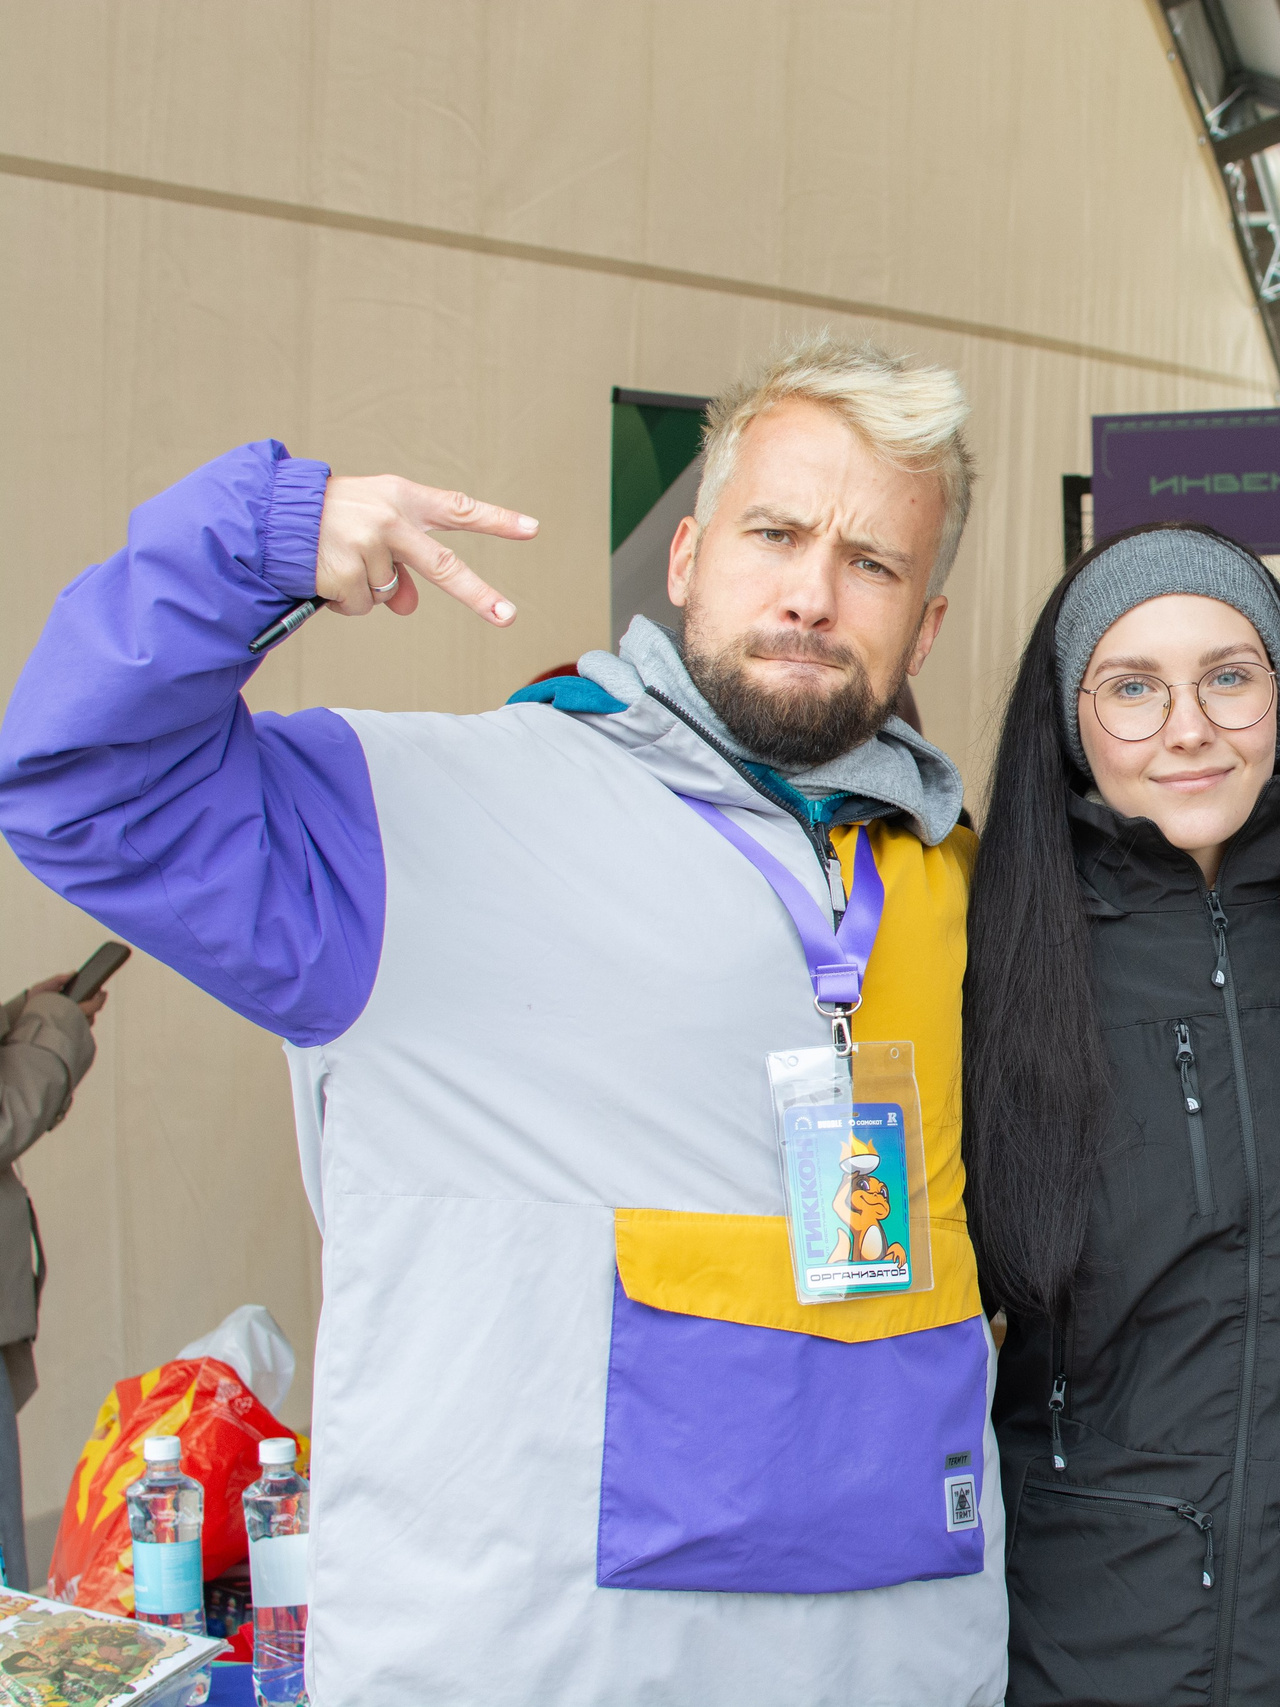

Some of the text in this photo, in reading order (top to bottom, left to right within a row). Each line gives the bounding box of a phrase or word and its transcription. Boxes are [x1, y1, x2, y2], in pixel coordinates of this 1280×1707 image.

[797, 1138, 825, 1259] ГИККОН
[810, 1267, 907, 1282] ОРГАНИЗАТОР
[955, 1510, 971, 1520] TRMT
